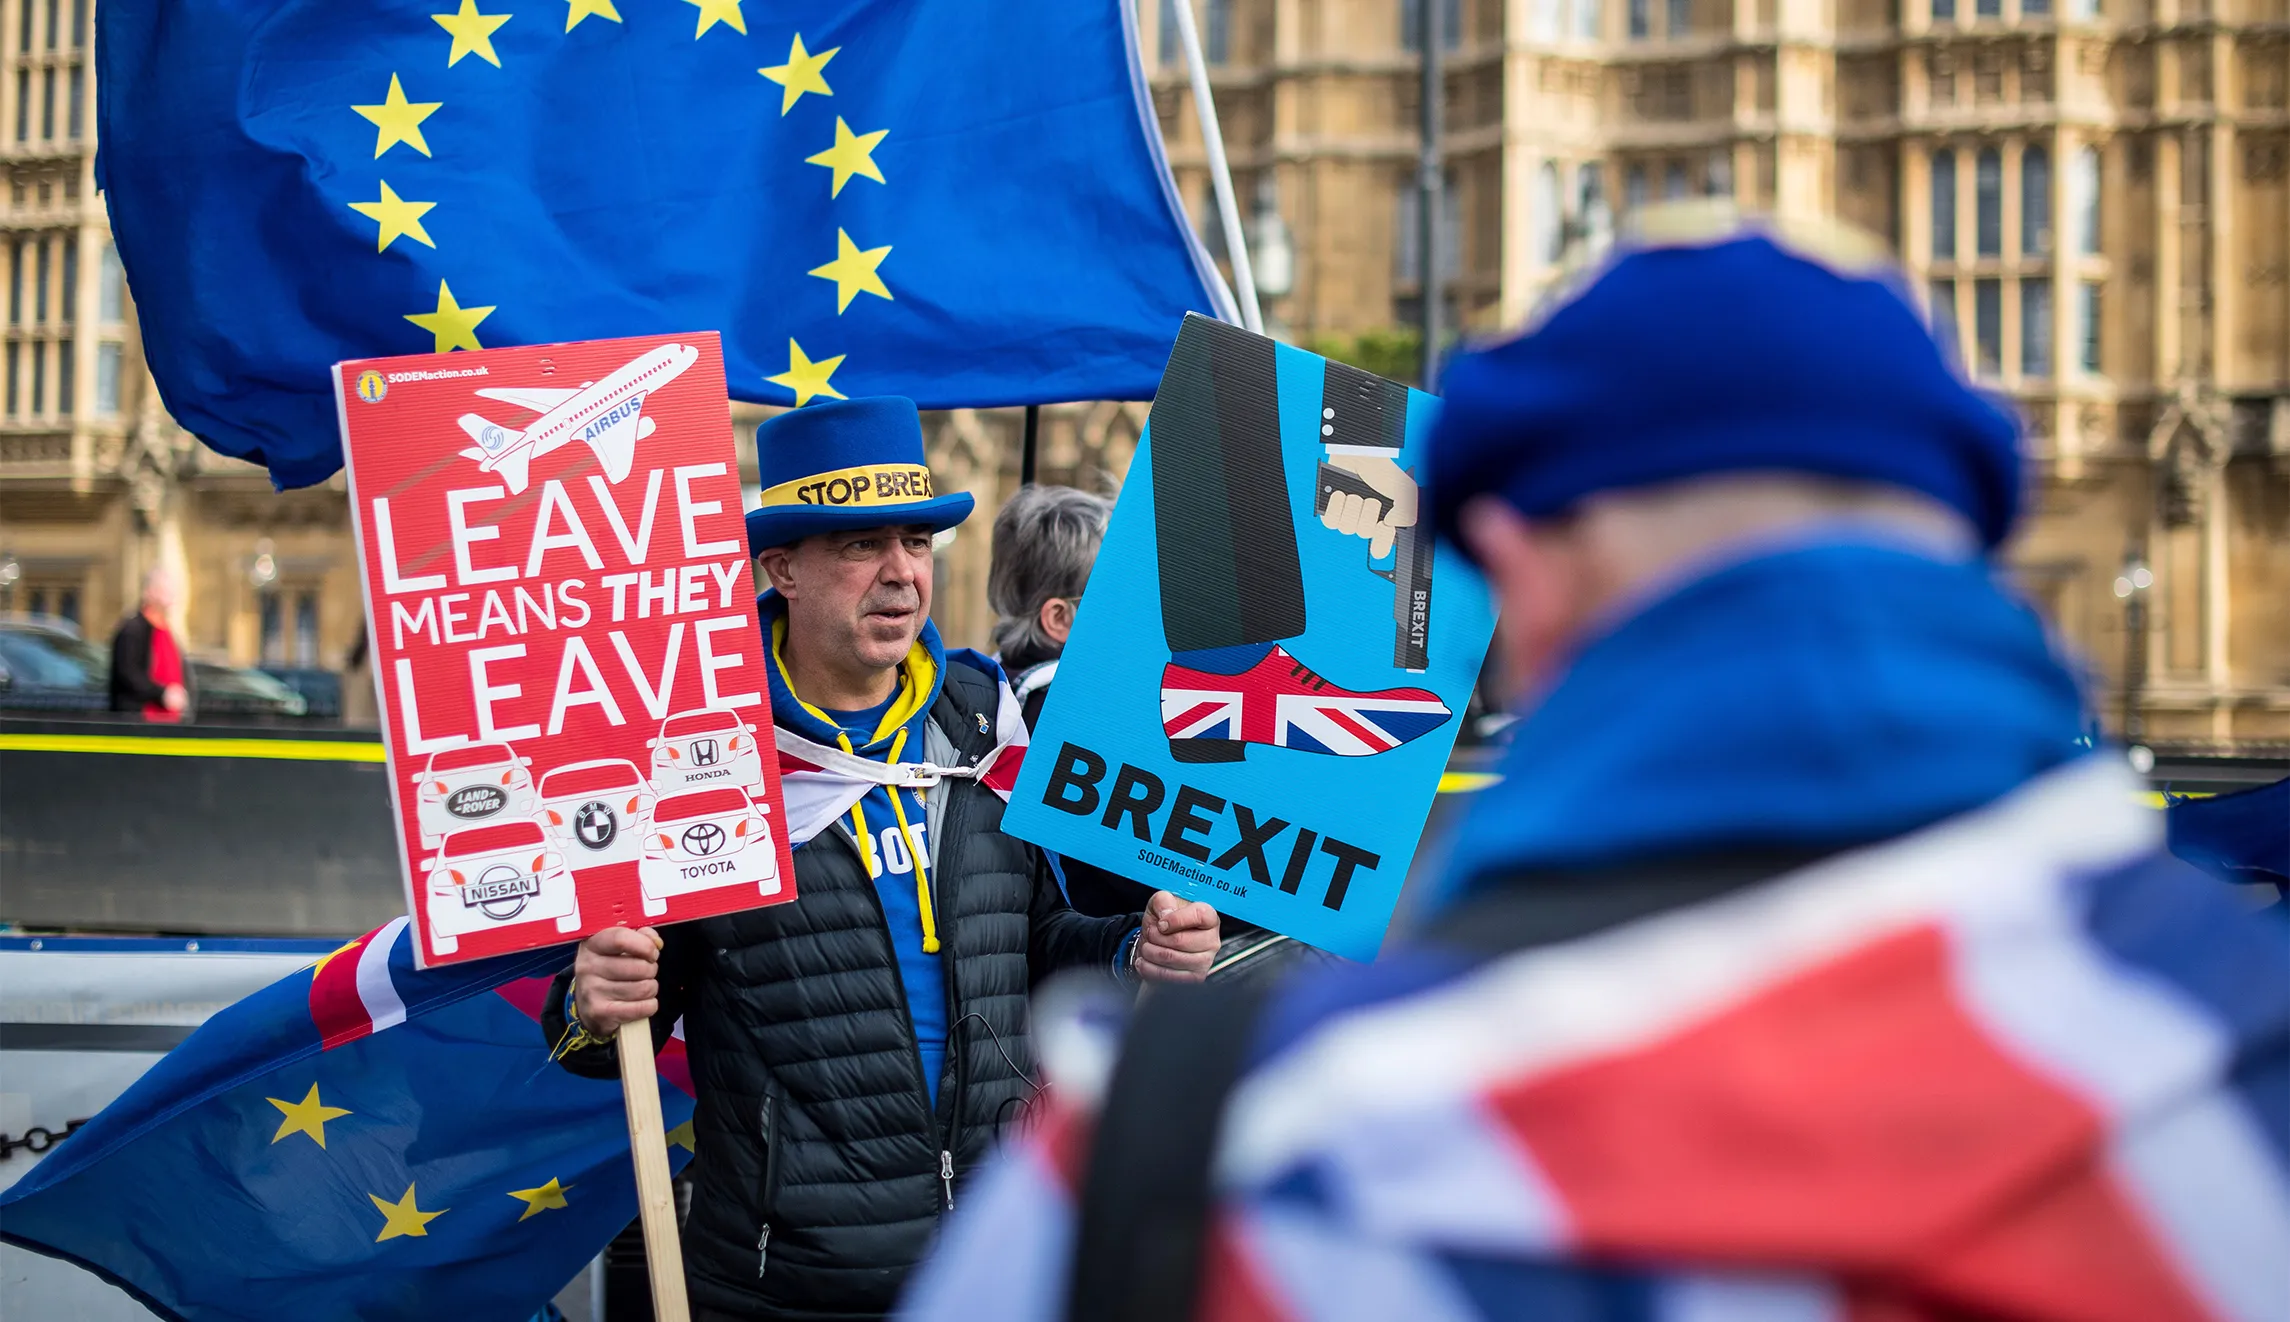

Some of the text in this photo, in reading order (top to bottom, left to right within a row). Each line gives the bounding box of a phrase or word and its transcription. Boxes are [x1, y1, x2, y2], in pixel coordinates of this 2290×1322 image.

[388, 366, 489, 383] SODEMaction.co.uk
[585, 397, 641, 441] AIRBUS
[797, 476, 870, 505] STOP
[373, 462, 740, 595] LEAVE
[392, 560, 746, 650] MEANS THEY
[1411, 591, 1427, 648] BREXIT
[395, 615, 762, 756] LEAVE
[685, 769, 731, 782] HONDA
[578, 802, 612, 819] BMW
[1041, 741, 1381, 912] BREXIT
[471, 879, 531, 900] NISSAN
[680, 860, 736, 879] TOYOTA
[1138, 849, 1248, 898] SODEMaction.co.uk
